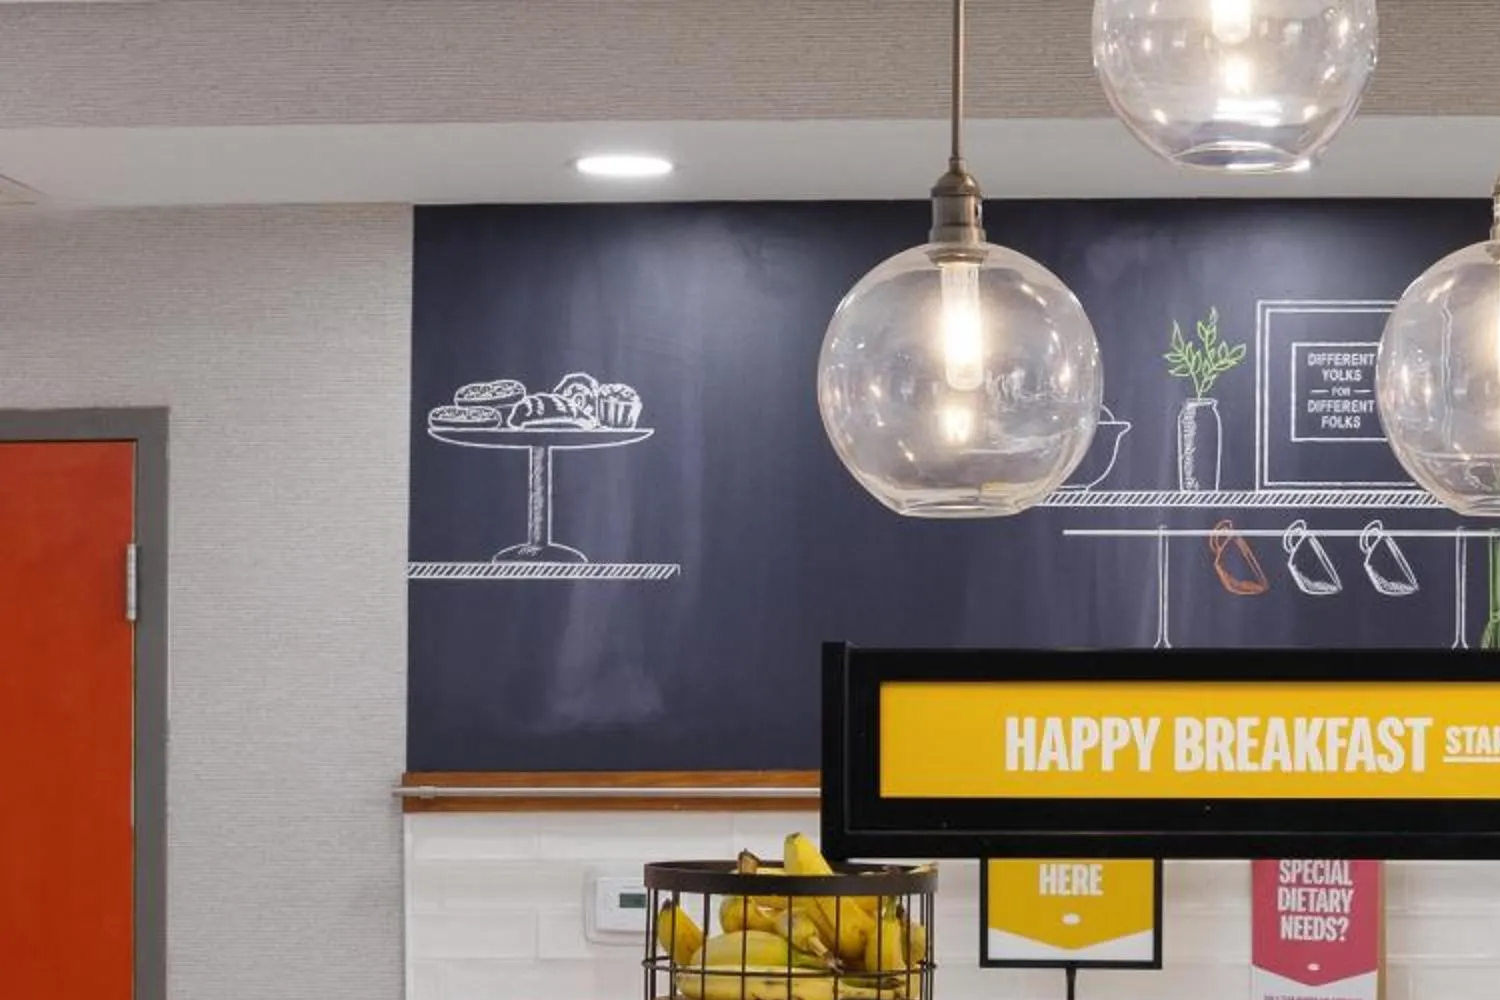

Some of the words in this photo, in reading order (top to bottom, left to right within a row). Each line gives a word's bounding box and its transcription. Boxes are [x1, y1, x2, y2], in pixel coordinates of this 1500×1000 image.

[1307, 352, 1375, 366] DIFFERENT
[1322, 369, 1362, 382] YOLKS
[1307, 399, 1375, 413] DIFFERENT
[1321, 415, 1361, 429] FOLKS
[1005, 715, 1161, 772] HAPPY
[1174, 716, 1434, 773] BREAKFAST
[1038, 863, 1105, 896] HERE
[1279, 859, 1353, 886] SPECIAL
[1277, 886, 1355, 914] DIETARY
[1280, 914, 1350, 942] NEEDS?
